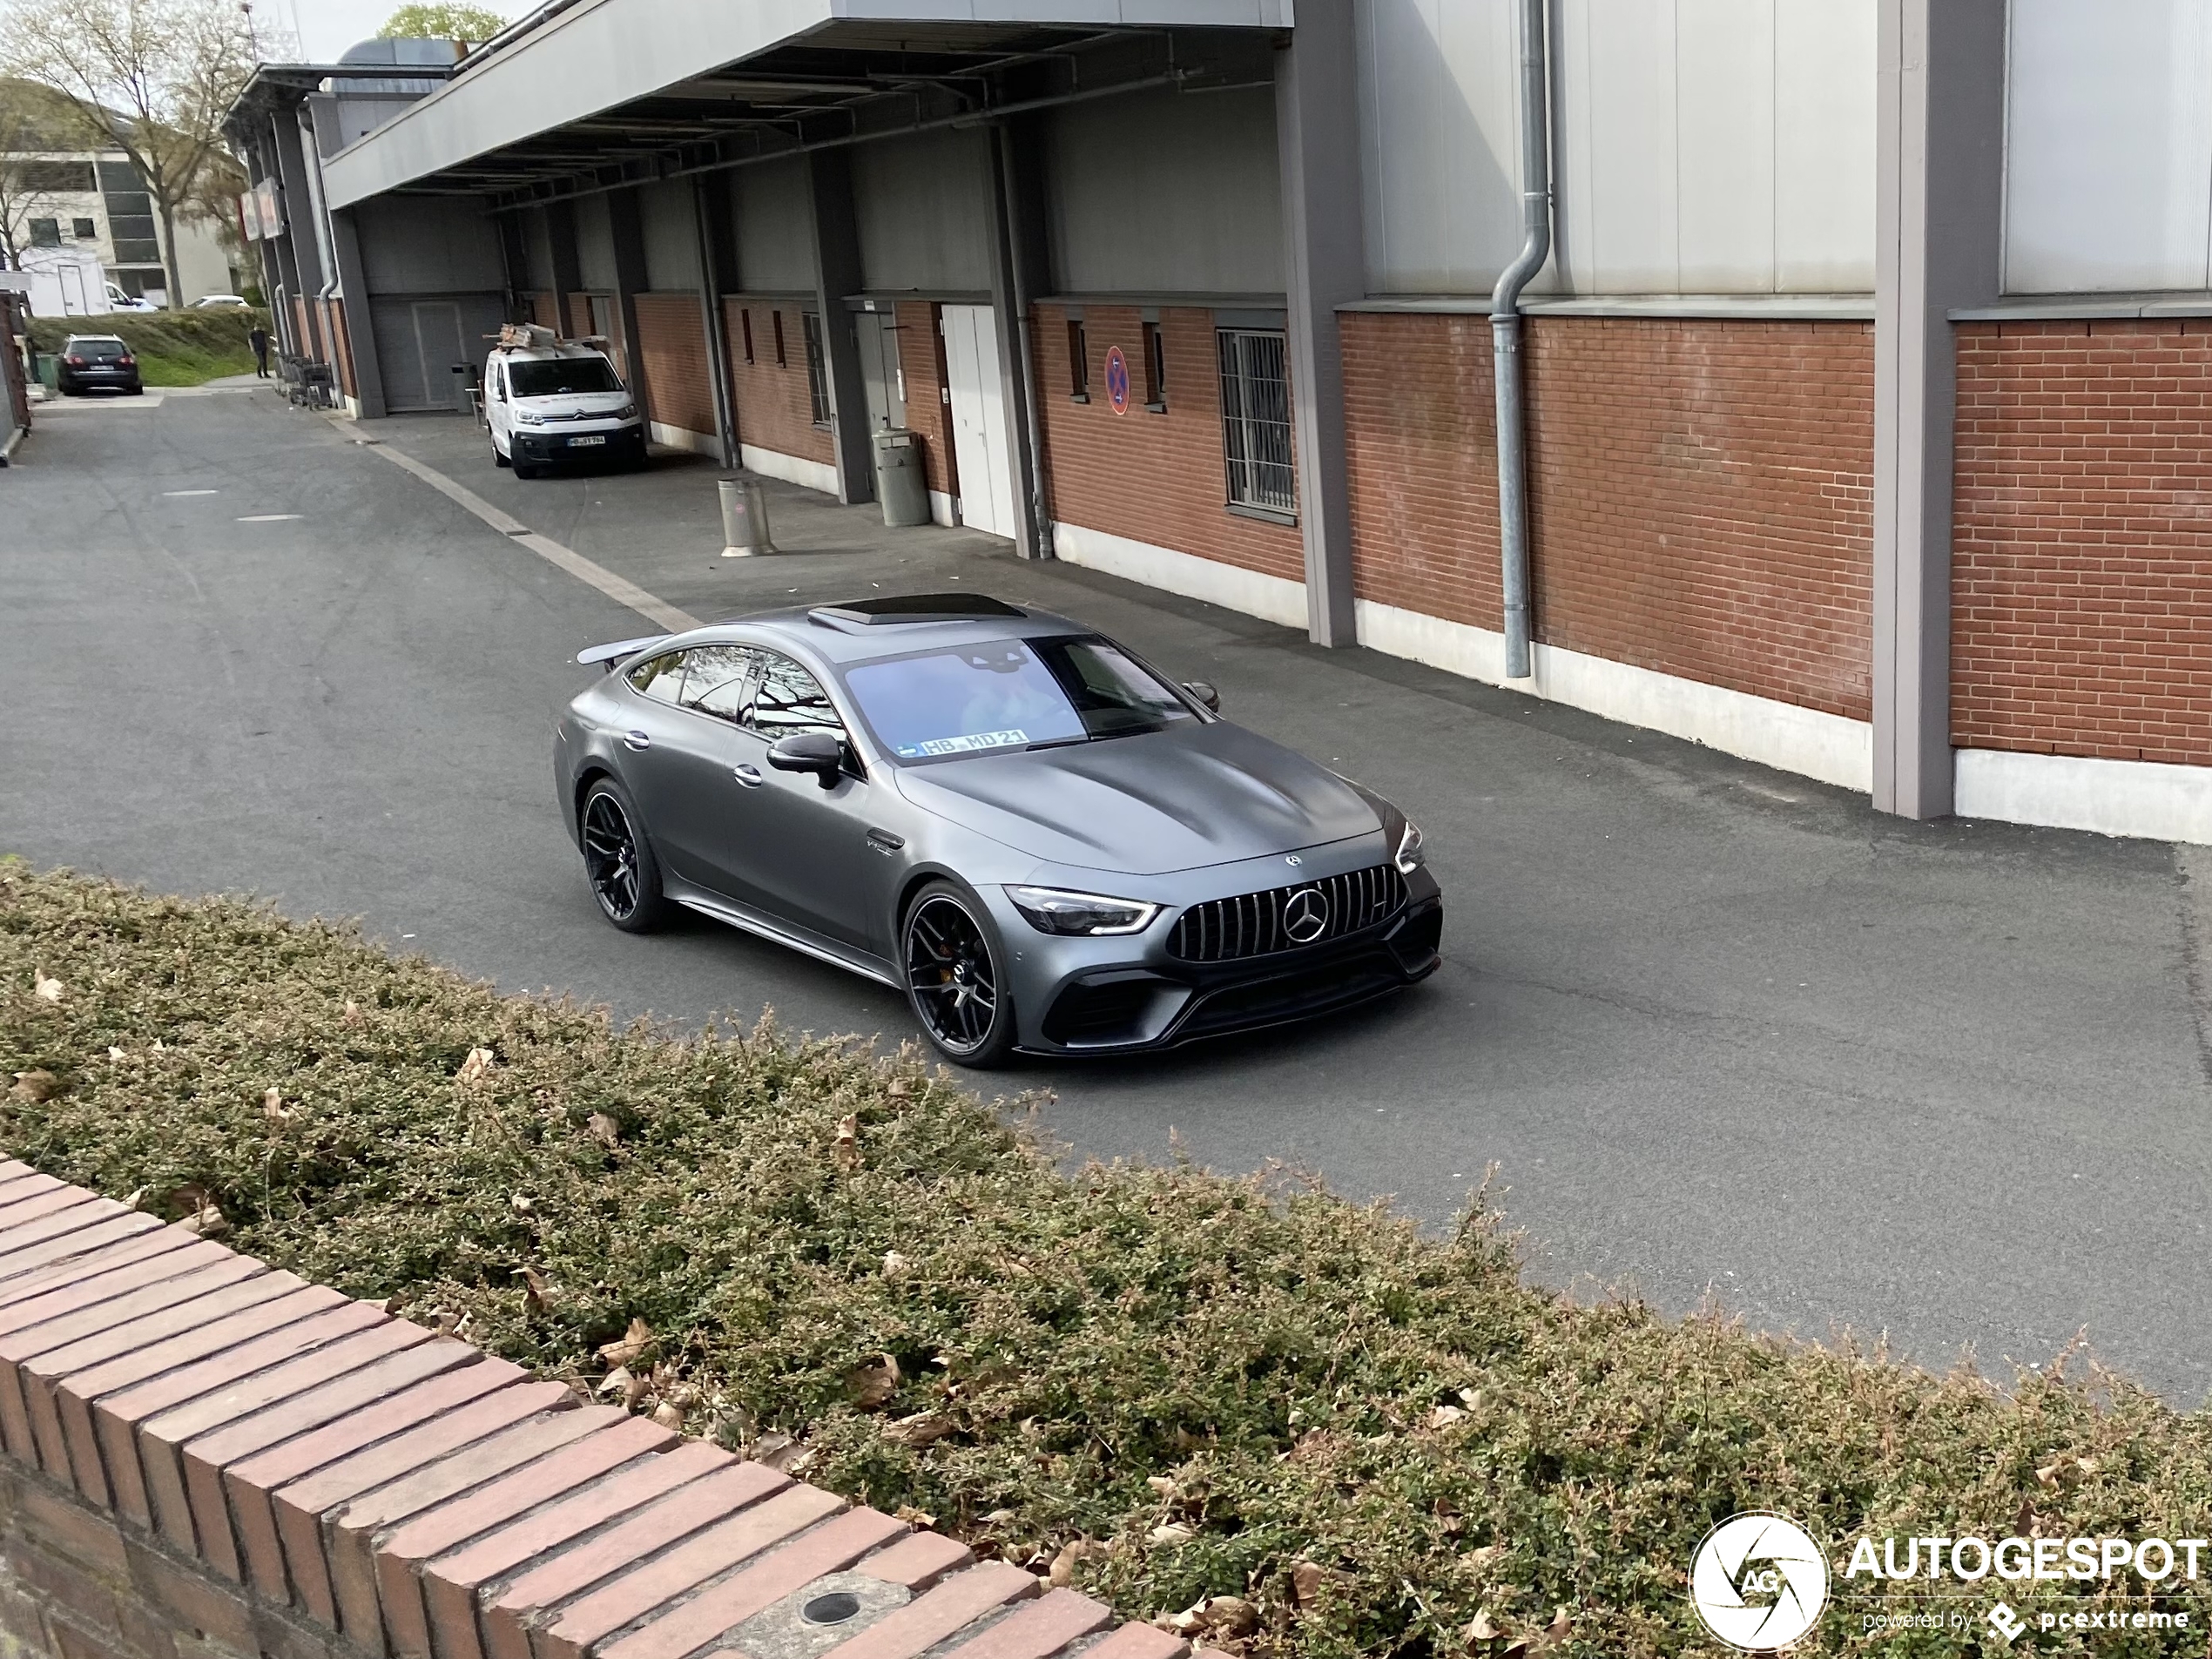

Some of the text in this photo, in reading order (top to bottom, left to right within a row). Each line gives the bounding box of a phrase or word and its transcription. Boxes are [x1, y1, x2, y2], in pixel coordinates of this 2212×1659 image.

[924, 731, 1028, 754] HB MD 21
